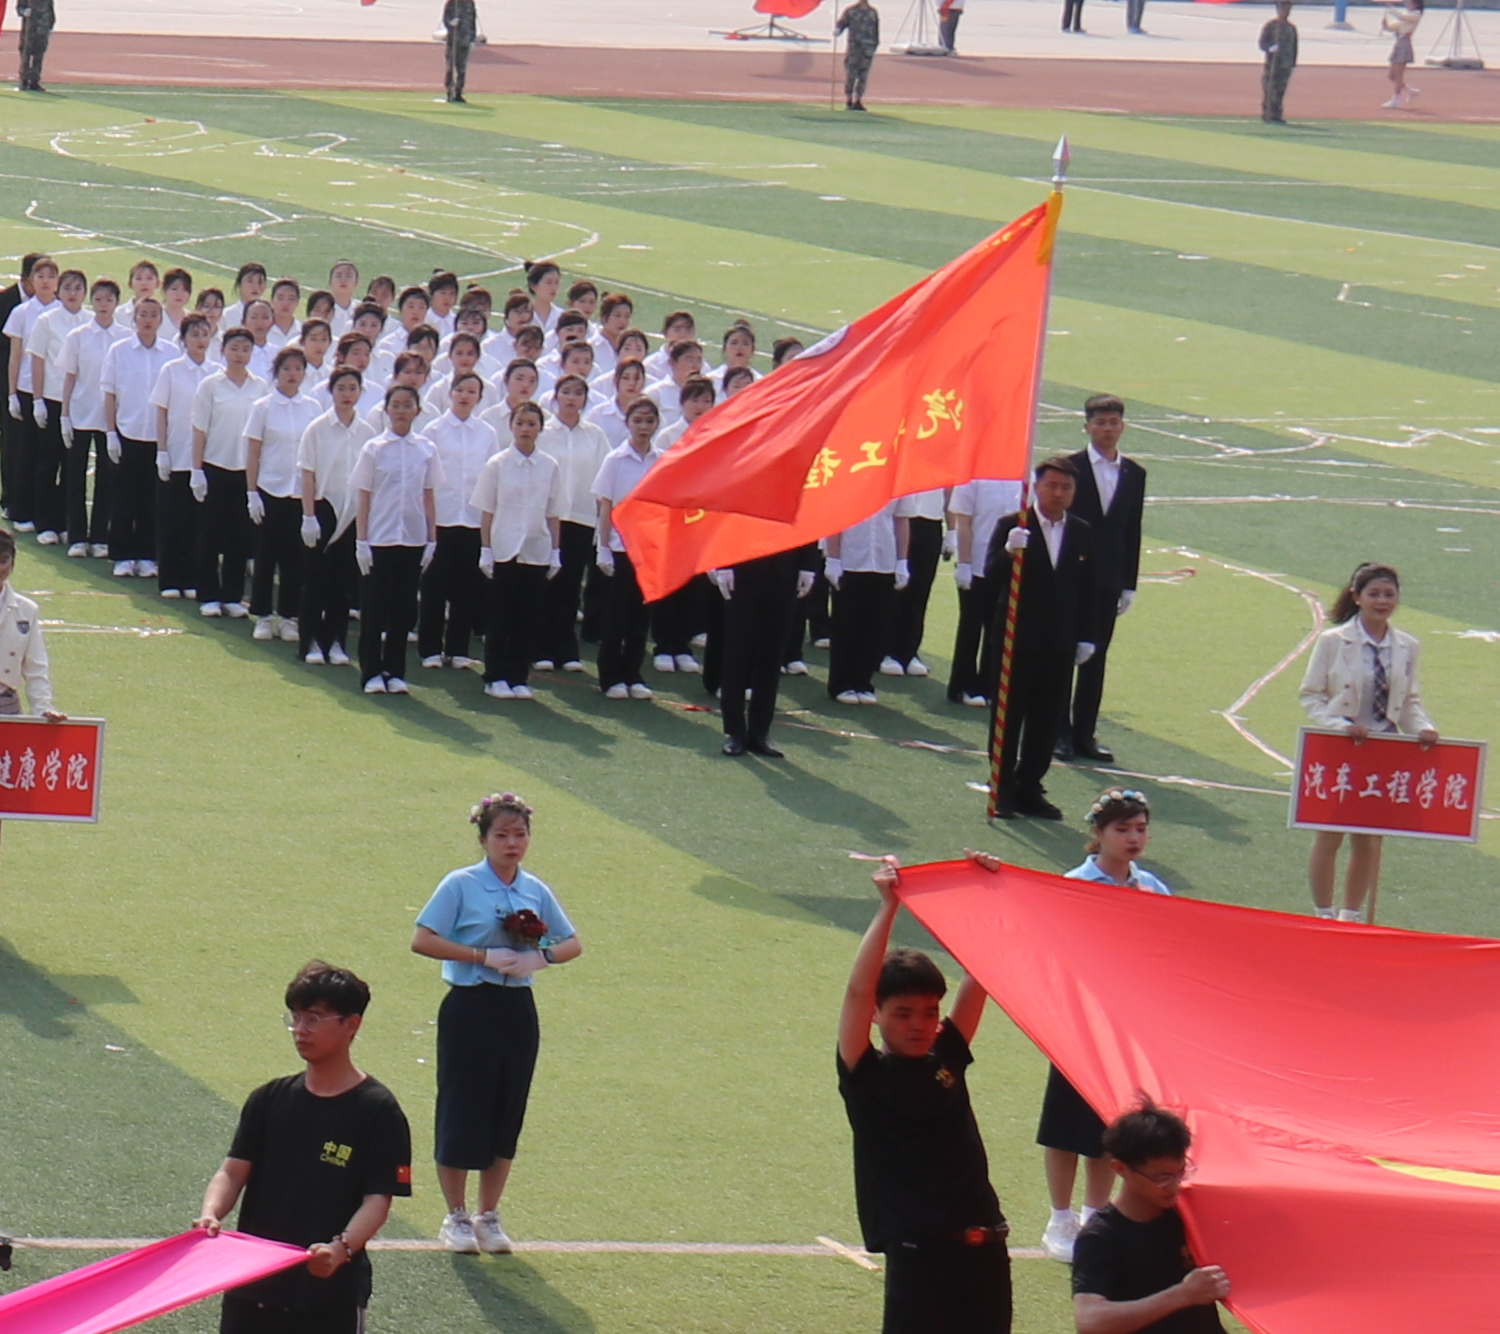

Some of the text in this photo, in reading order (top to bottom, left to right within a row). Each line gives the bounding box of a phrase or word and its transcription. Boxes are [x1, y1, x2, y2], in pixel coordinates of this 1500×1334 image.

[1303, 762, 1468, 811] 汽车工程学院
[322, 1141, 353, 1162] 中国
